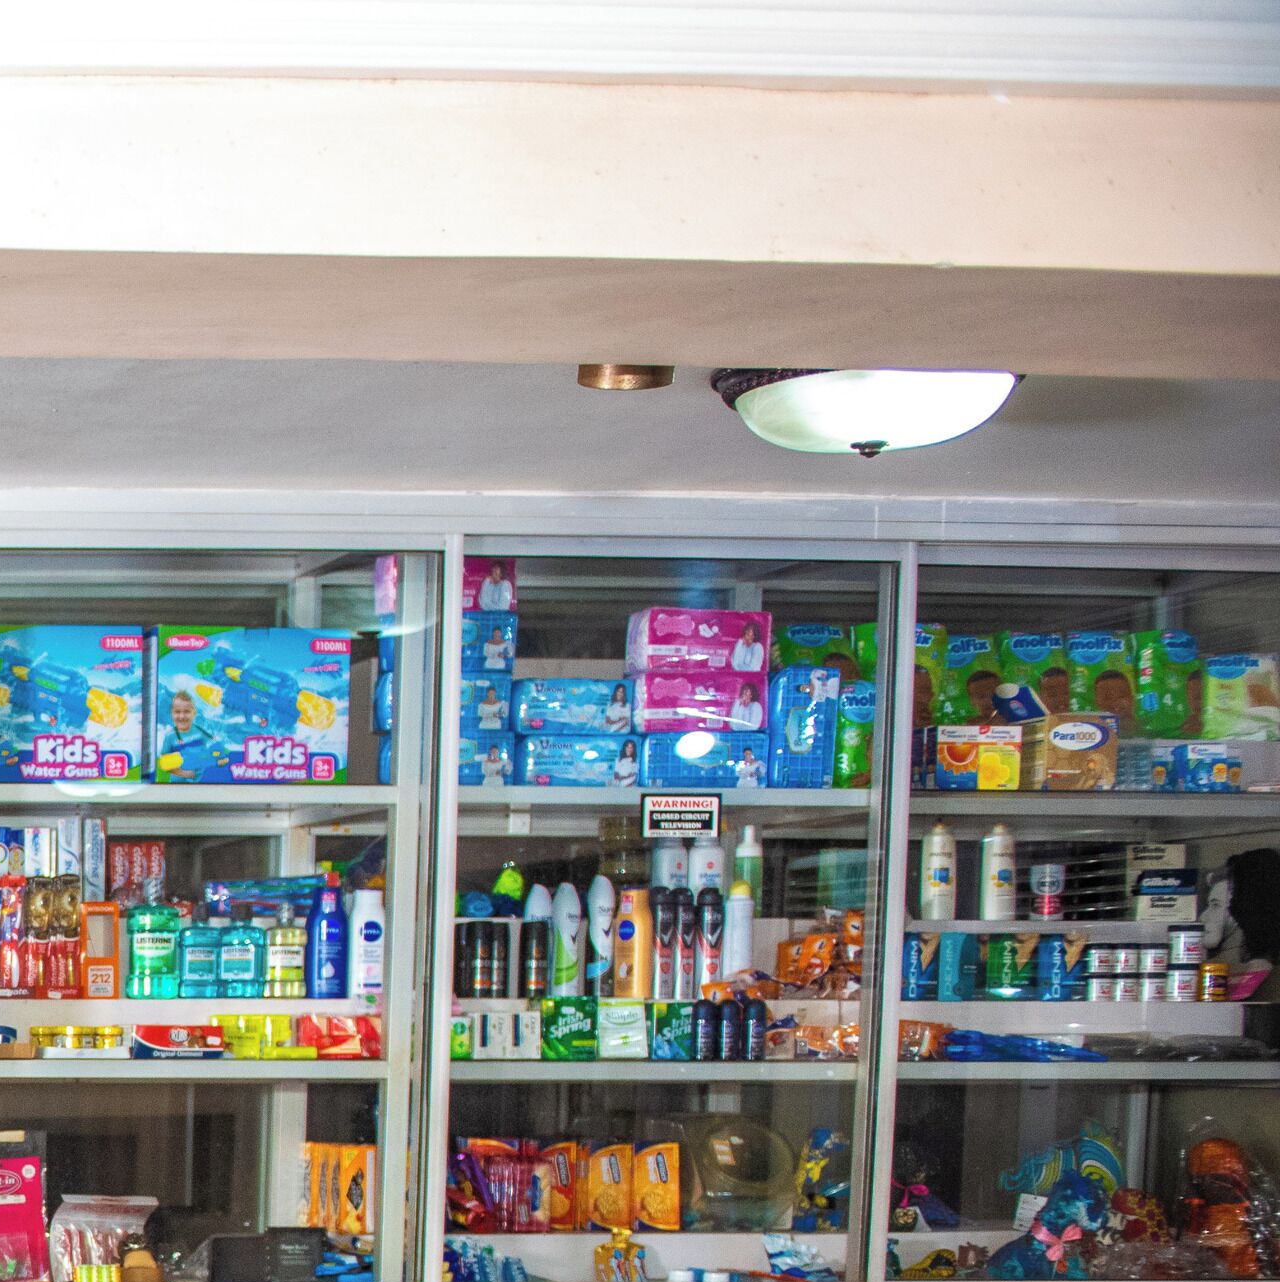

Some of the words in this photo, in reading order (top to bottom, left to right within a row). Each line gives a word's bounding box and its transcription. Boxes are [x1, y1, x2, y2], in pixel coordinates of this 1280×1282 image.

[105, 637, 139, 649] 1100ML
[314, 640, 347, 652] 1100ML
[1052, 730, 1098, 742] Para1000
[37, 737, 98, 764] Kids
[247, 740, 306, 766] Kids
[109, 758, 122, 769] 3+
[316, 760, 329, 771] 3+
[20, 764, 61, 777] Water
[64, 764, 100, 777] Guns
[231, 765, 269, 779] Water
[272, 766, 306, 779] Guns
[651, 799, 713, 809] WARNING!
[652, 812, 680, 820] CLOSED
[681, 812, 710, 820] CIRCUIT
[660, 821, 702, 829] TELEVISION
[1142, 876, 1182, 887] Gillette
[135, 936, 173, 945] LISTERINE
[908, 940, 919, 998] DENIM
[944, 939, 954, 996] DENIM
[1051, 940, 1064, 999] DENIM
[90, 973, 112, 984] 212
[558, 1009, 584, 1027] Irish
[605, 1008, 639, 1021] Simple
[549, 1019, 591, 1039] Spring
